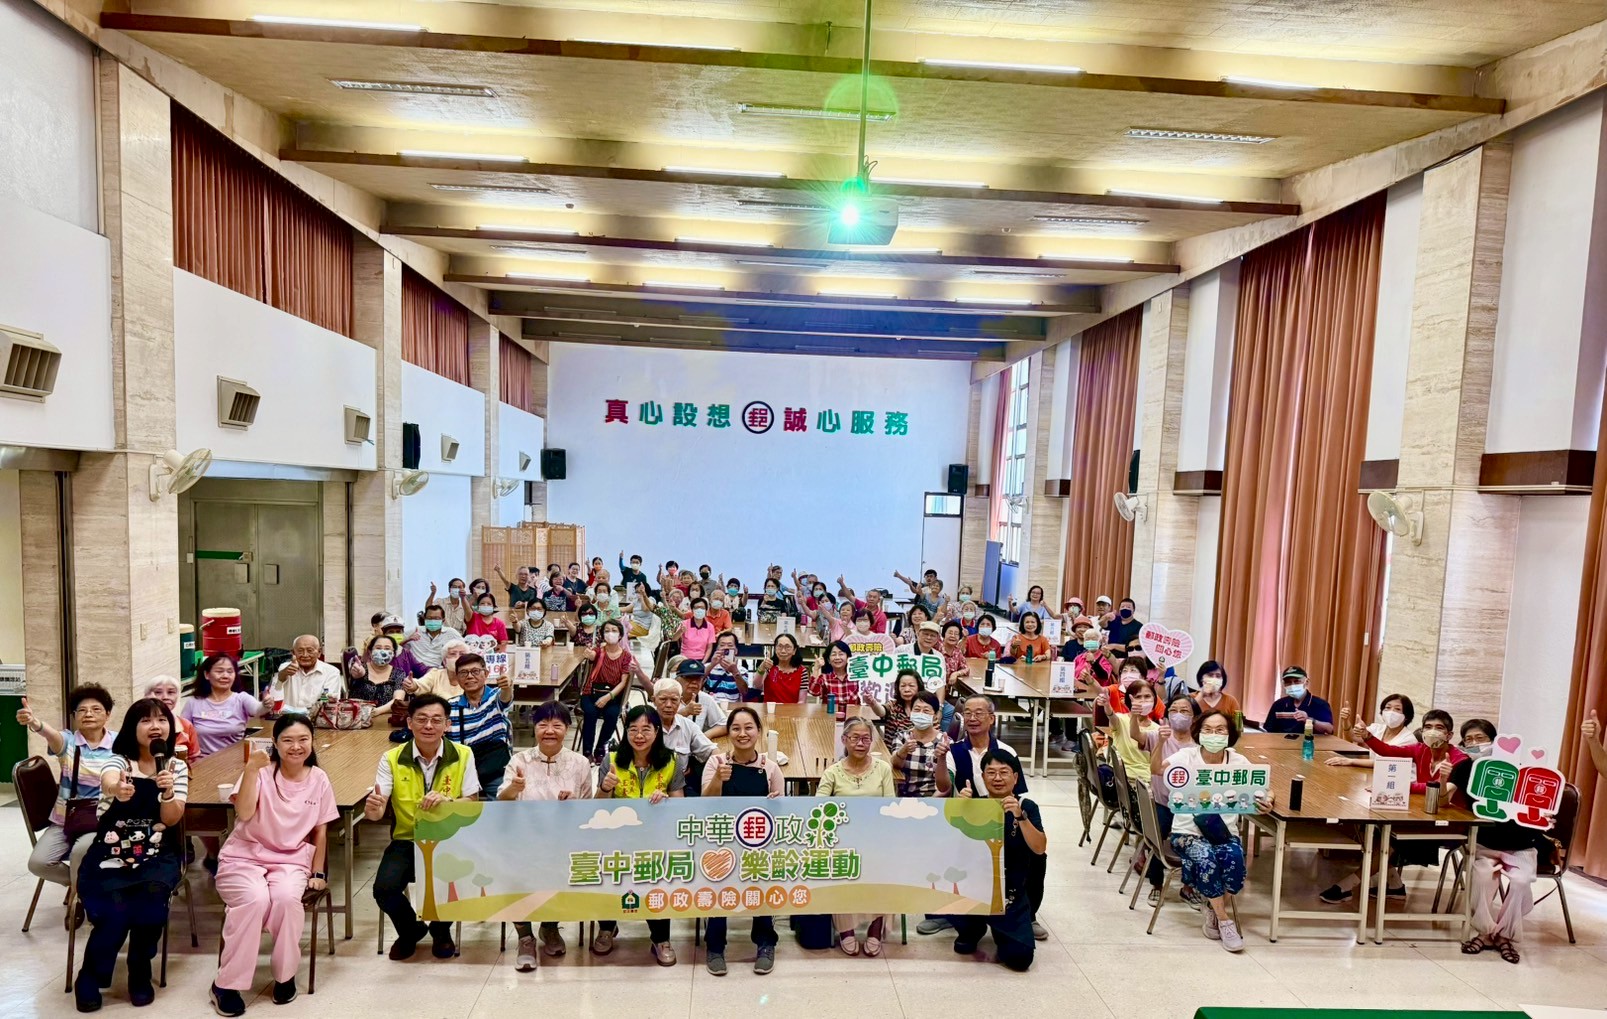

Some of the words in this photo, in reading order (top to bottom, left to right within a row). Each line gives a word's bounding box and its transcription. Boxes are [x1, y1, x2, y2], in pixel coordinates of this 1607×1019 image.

[848, 653, 943, 679] 臺中郵局
[1169, 768, 1187, 786] 郵
[1196, 769, 1266, 786] 臺中郵局
[1386, 764, 1397, 790] 第一組
[678, 808, 803, 847] 中華郵政
[569, 850, 694, 885] 臺中郵局
[740, 848, 862, 882] 樂齡運動
[647, 887, 810, 911] 郵政壽險關心您
